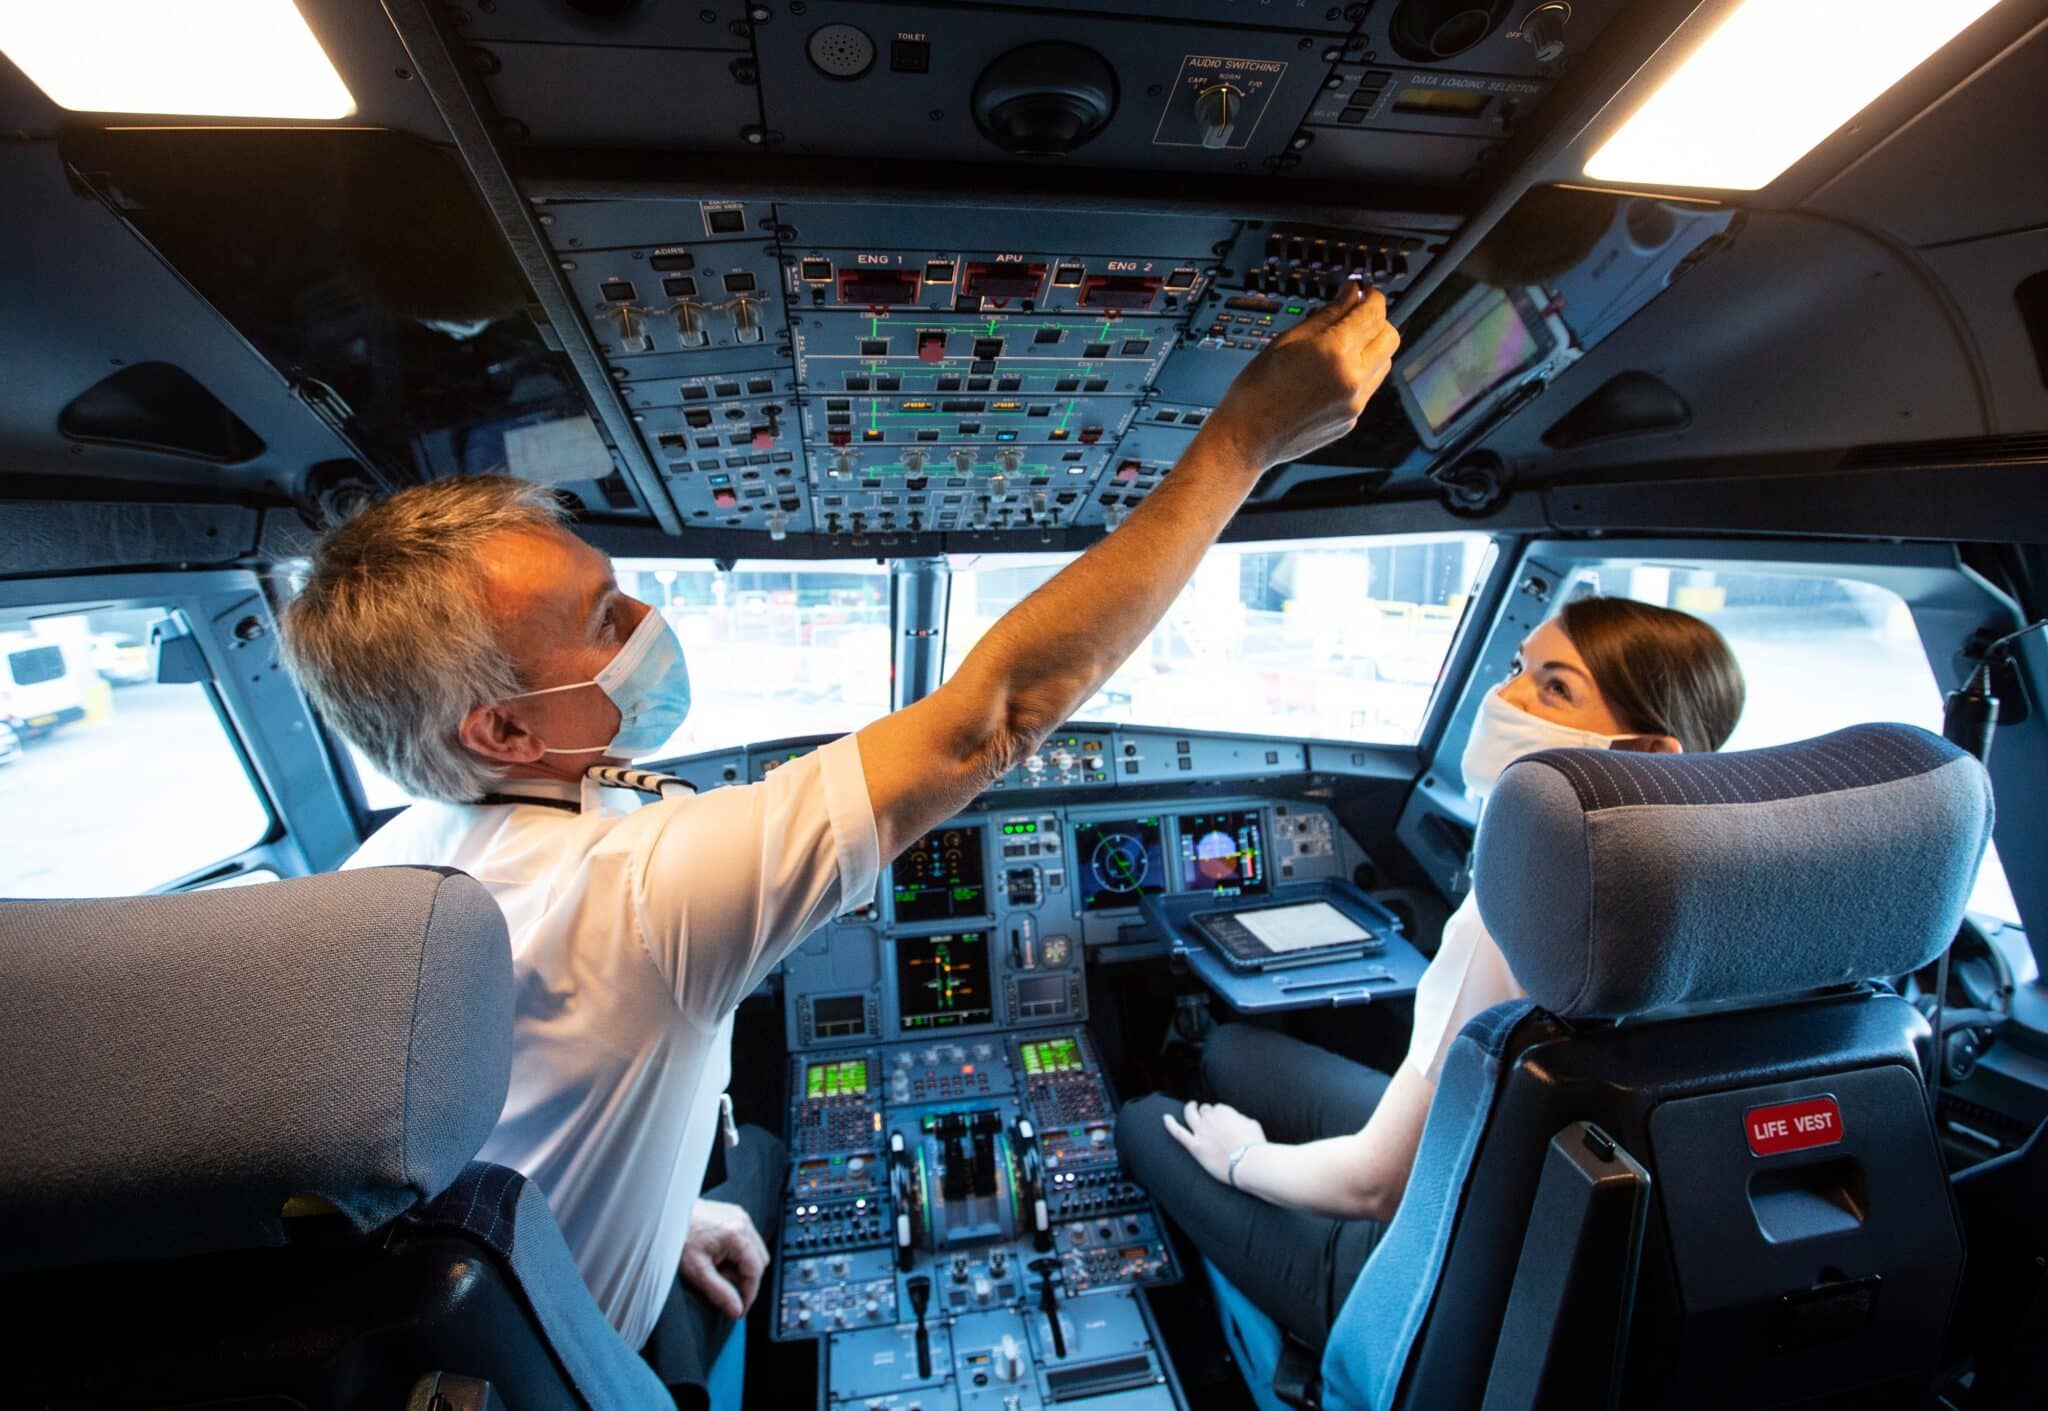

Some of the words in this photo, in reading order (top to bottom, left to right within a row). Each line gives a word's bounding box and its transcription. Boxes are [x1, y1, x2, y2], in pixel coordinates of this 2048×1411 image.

[897, 32, 926, 40] TOILET
[1188, 57, 1222, 69] AUDIO
[1224, 60, 1281, 73] SWITCHING
[1411, 74, 1437, 85] DATA
[1440, 77, 1486, 89] LOADING
[1487, 79, 1542, 93] SELECTOR
[654, 247, 685, 256] ADIRS
[857, 254, 889, 264] ENG
[896, 254, 903, 264] 1
[995, 254, 1024, 263] APU
[1107, 261, 1137, 271] ENG
[1143, 261, 1153, 272] 2
[1754, 1120, 1789, 1140] LIFE
[1793, 1112, 1832, 1133] VEST
